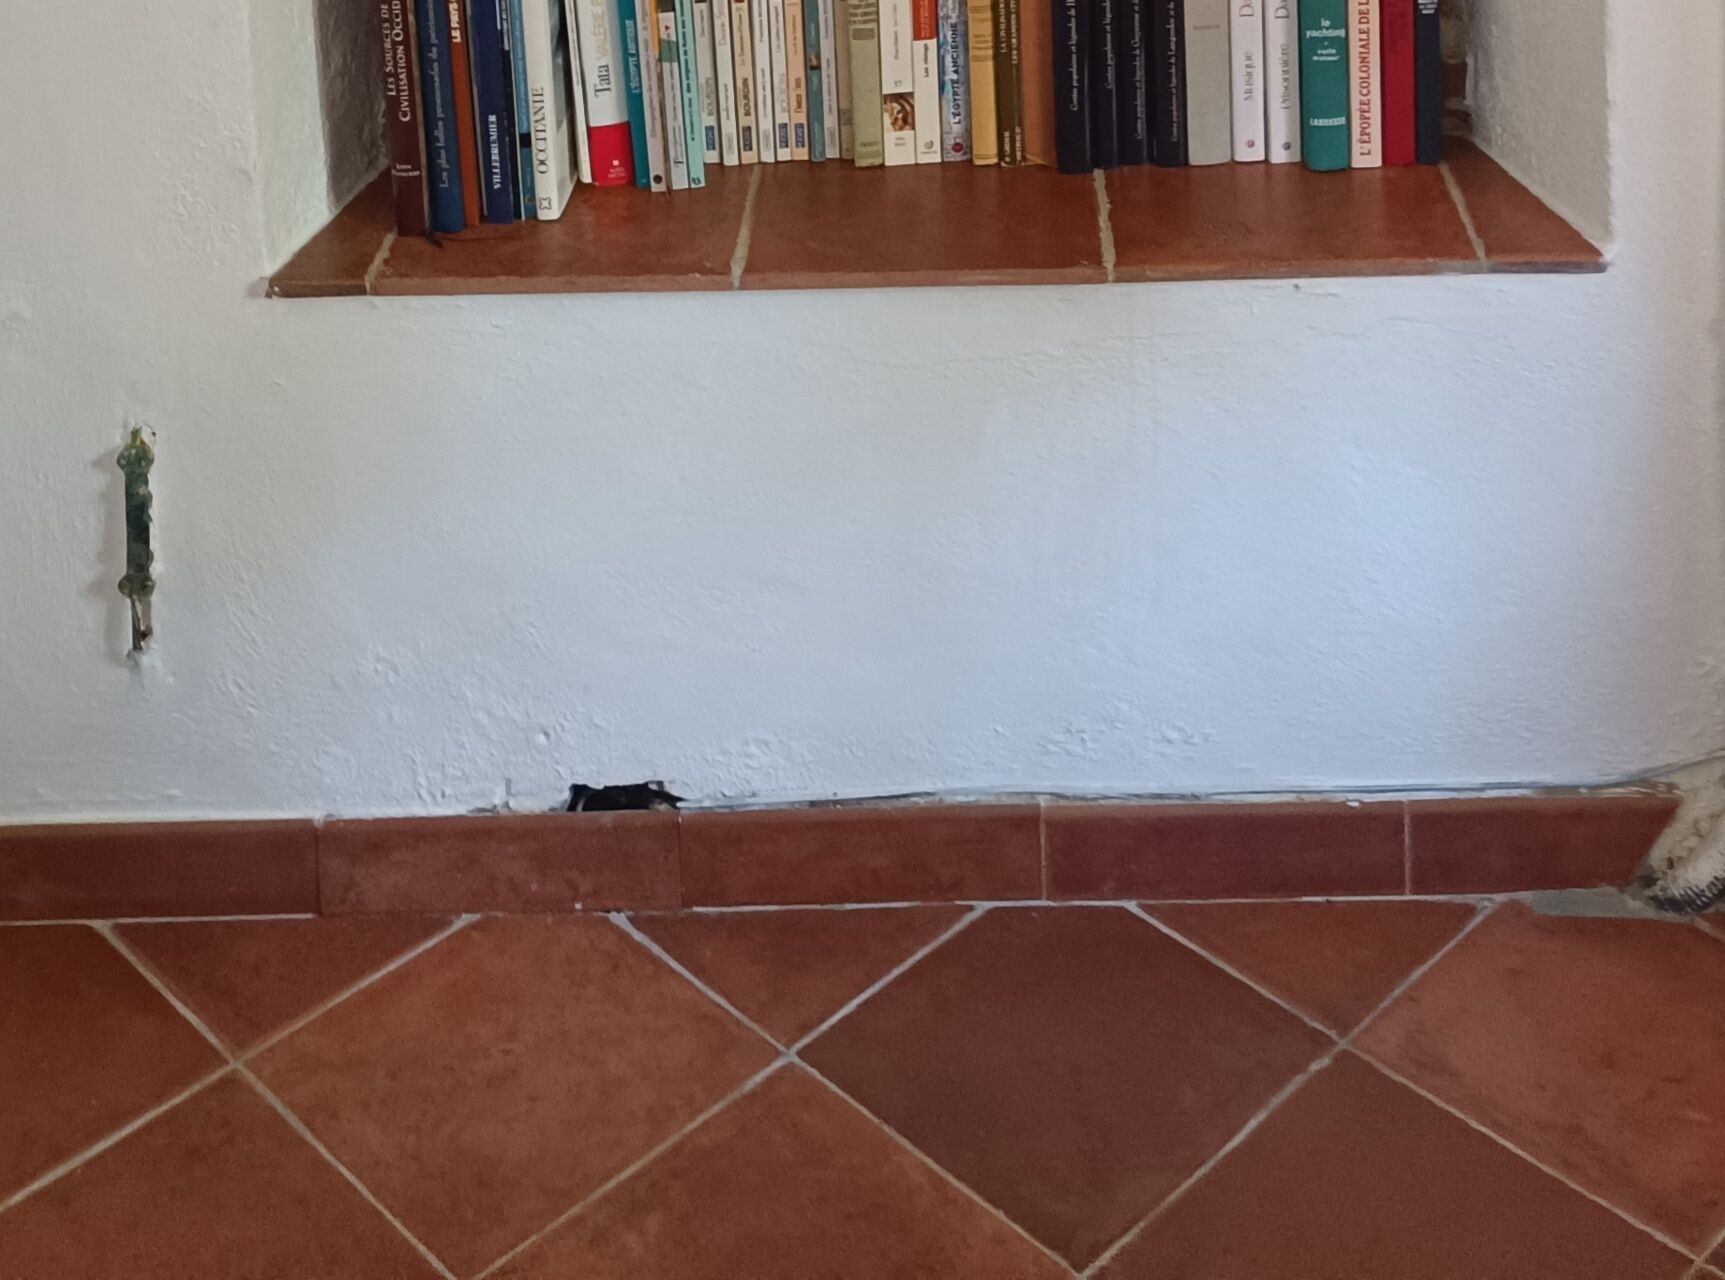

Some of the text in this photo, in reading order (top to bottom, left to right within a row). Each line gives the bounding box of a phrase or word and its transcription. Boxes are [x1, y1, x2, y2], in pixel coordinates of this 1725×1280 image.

[591, 11, 608, 61] VALÉRIE
[1357, 8, 1370, 25] DE
[950, 23, 960, 75] ANCIENNE
[1357, 27, 1371, 97] COLONIALE
[395, 45, 411, 121] CIVILISATION
[594, 64, 611, 97] Tata
[742, 78, 752, 117] BOURDIN
[1242, 50, 1256, 101] Musique
[949, 79, 961, 125] L'ÉGYPTE
[488, 114, 501, 189] VILLEBRUMIER
[531, 86, 549, 174] OCCITANIE
